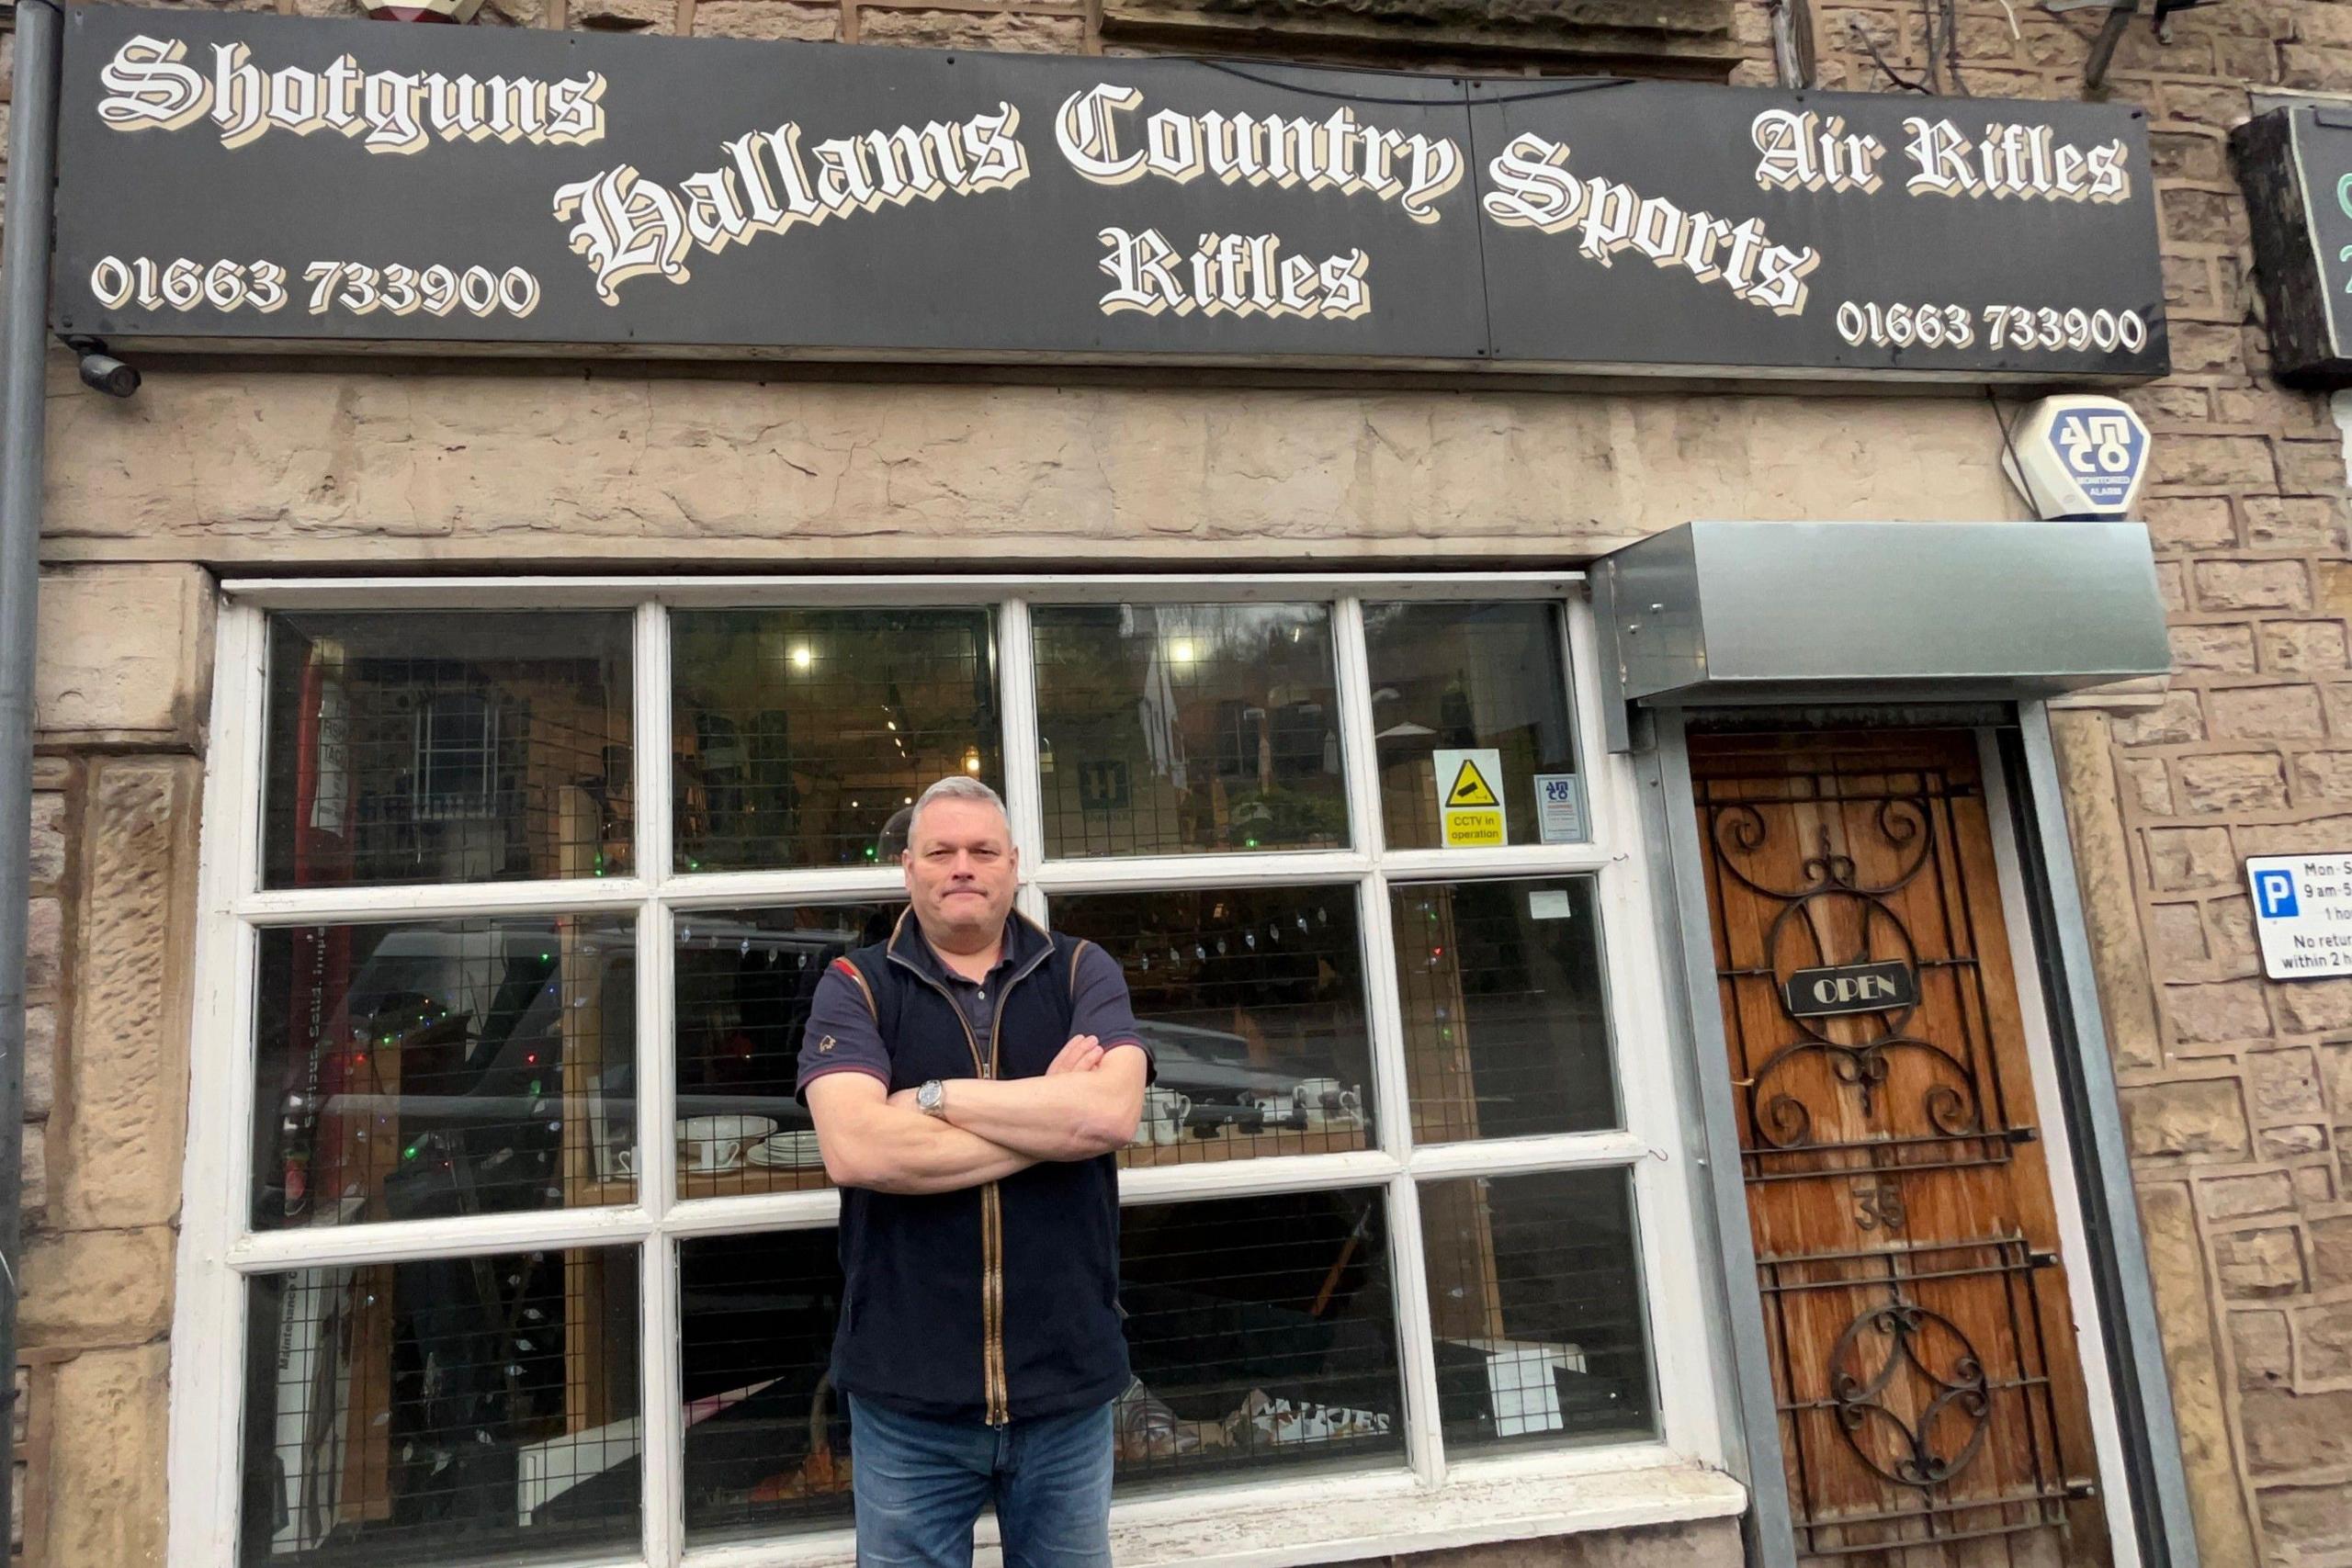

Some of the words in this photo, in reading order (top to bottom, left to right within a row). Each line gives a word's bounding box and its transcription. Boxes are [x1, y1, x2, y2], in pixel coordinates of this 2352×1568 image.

[97, 35, 607, 154] Shotguns
[1751, 108, 1886, 195] Air
[1903, 117, 2132, 204] Rifles
[551, 101, 1031, 306] Hallams
[1056, 83, 1464, 224] Country
[1482, 132, 1820, 316] Sports
[90, 254, 288, 314] 01663
[302, 260, 540, 318] 733900
[1098, 227, 1373, 320] Rifles
[1836, 300, 1973, 349] 01663
[1983, 305, 2147, 354] 733900
[1452, 829, 1499, 840] operation
[1453, 816, 1482, 826] CCTV
[1486, 816, 1494, 825] in
[2303, 862, 2335, 876] Mon
[2281, 953, 2327, 969] within
[2330, 952, 2340, 966] 2
[2293, 934, 2315, 949] No
[1813, 974, 1897, 1004] OPEN
